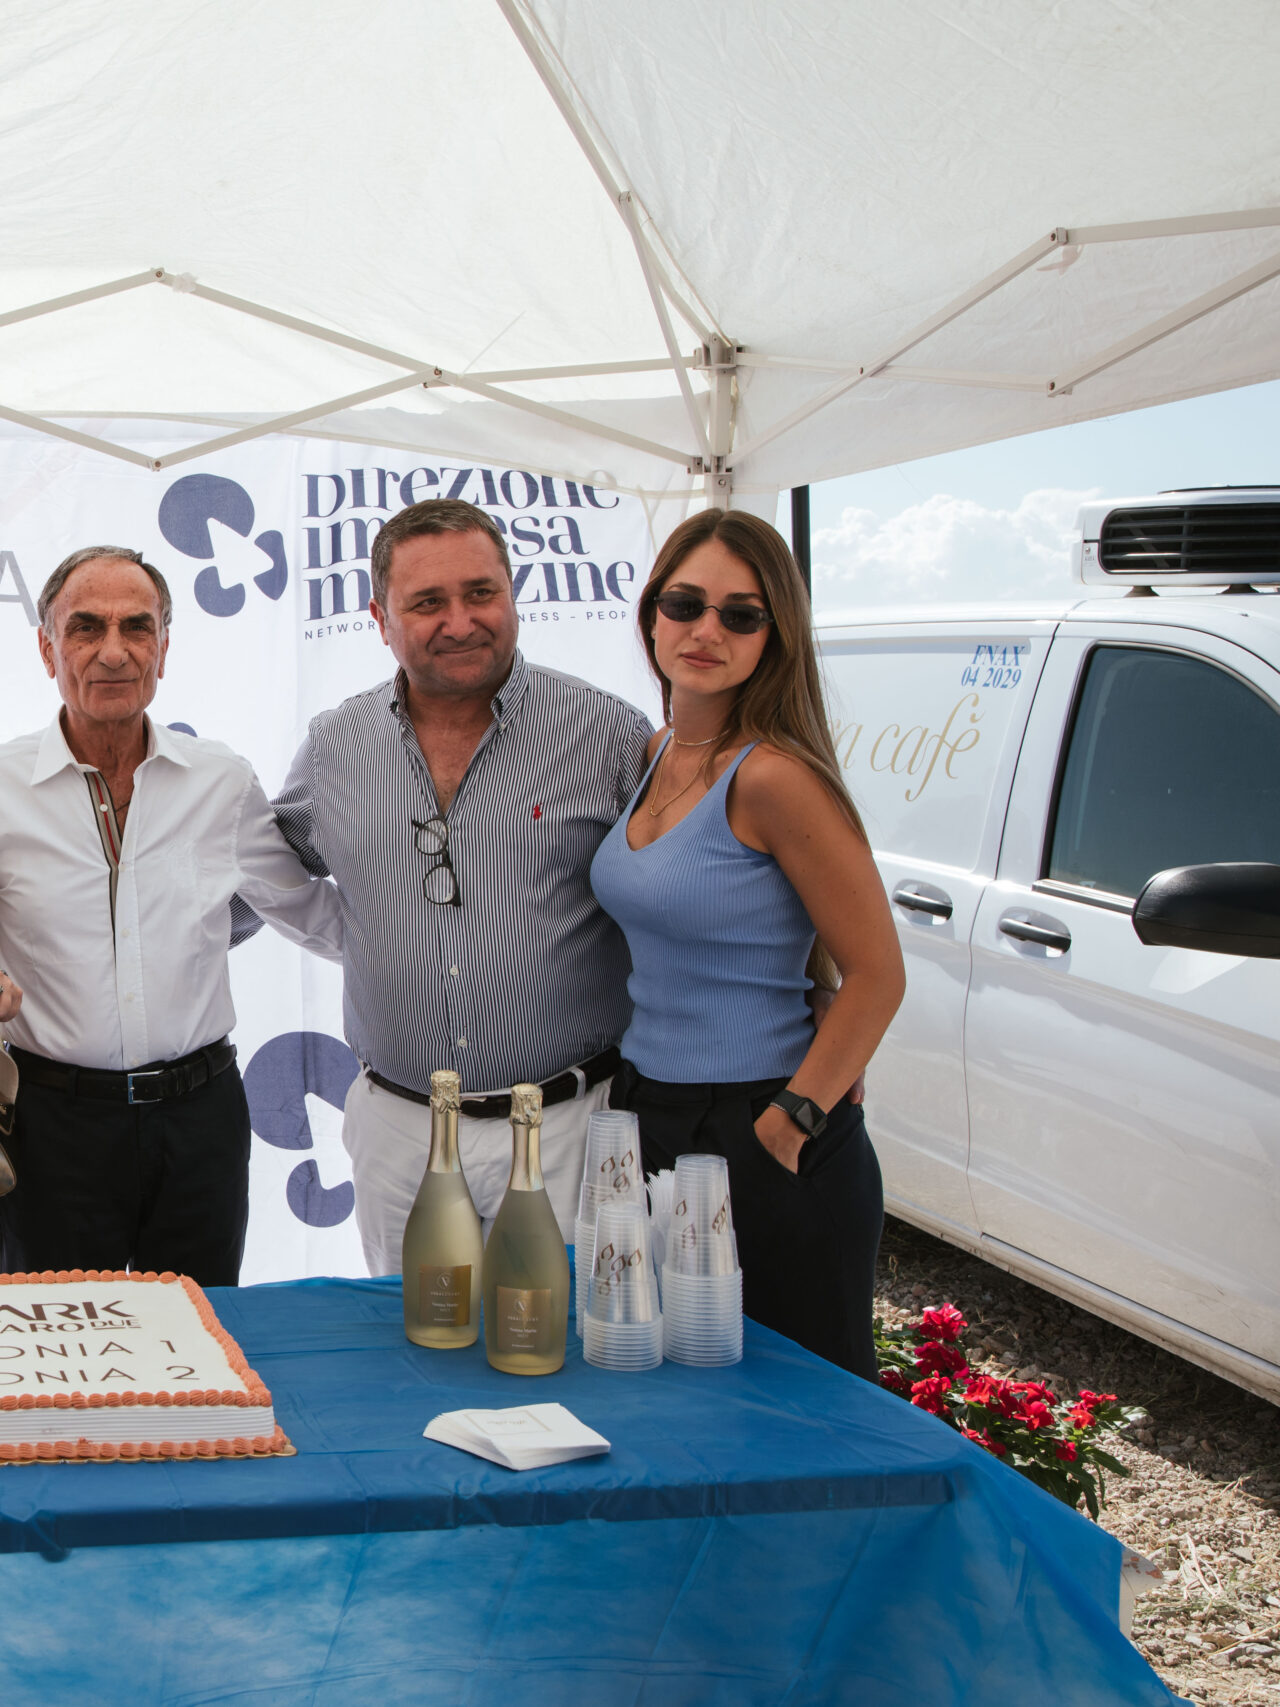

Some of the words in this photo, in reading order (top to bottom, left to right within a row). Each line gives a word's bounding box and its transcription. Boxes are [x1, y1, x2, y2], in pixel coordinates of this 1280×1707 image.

[304, 560, 634, 621] mzine
[304, 620, 376, 640] NETWOR
[586, 610, 627, 621] PEOP
[971, 644, 1026, 666] FNAX
[961, 666, 980, 687] 04
[982, 666, 1022, 689] 2029
[870, 692, 985, 802] café
[90, 1319, 142, 1329] DUE
[160, 1340, 177, 1354] 1
[165, 1365, 200, 1380] 2
